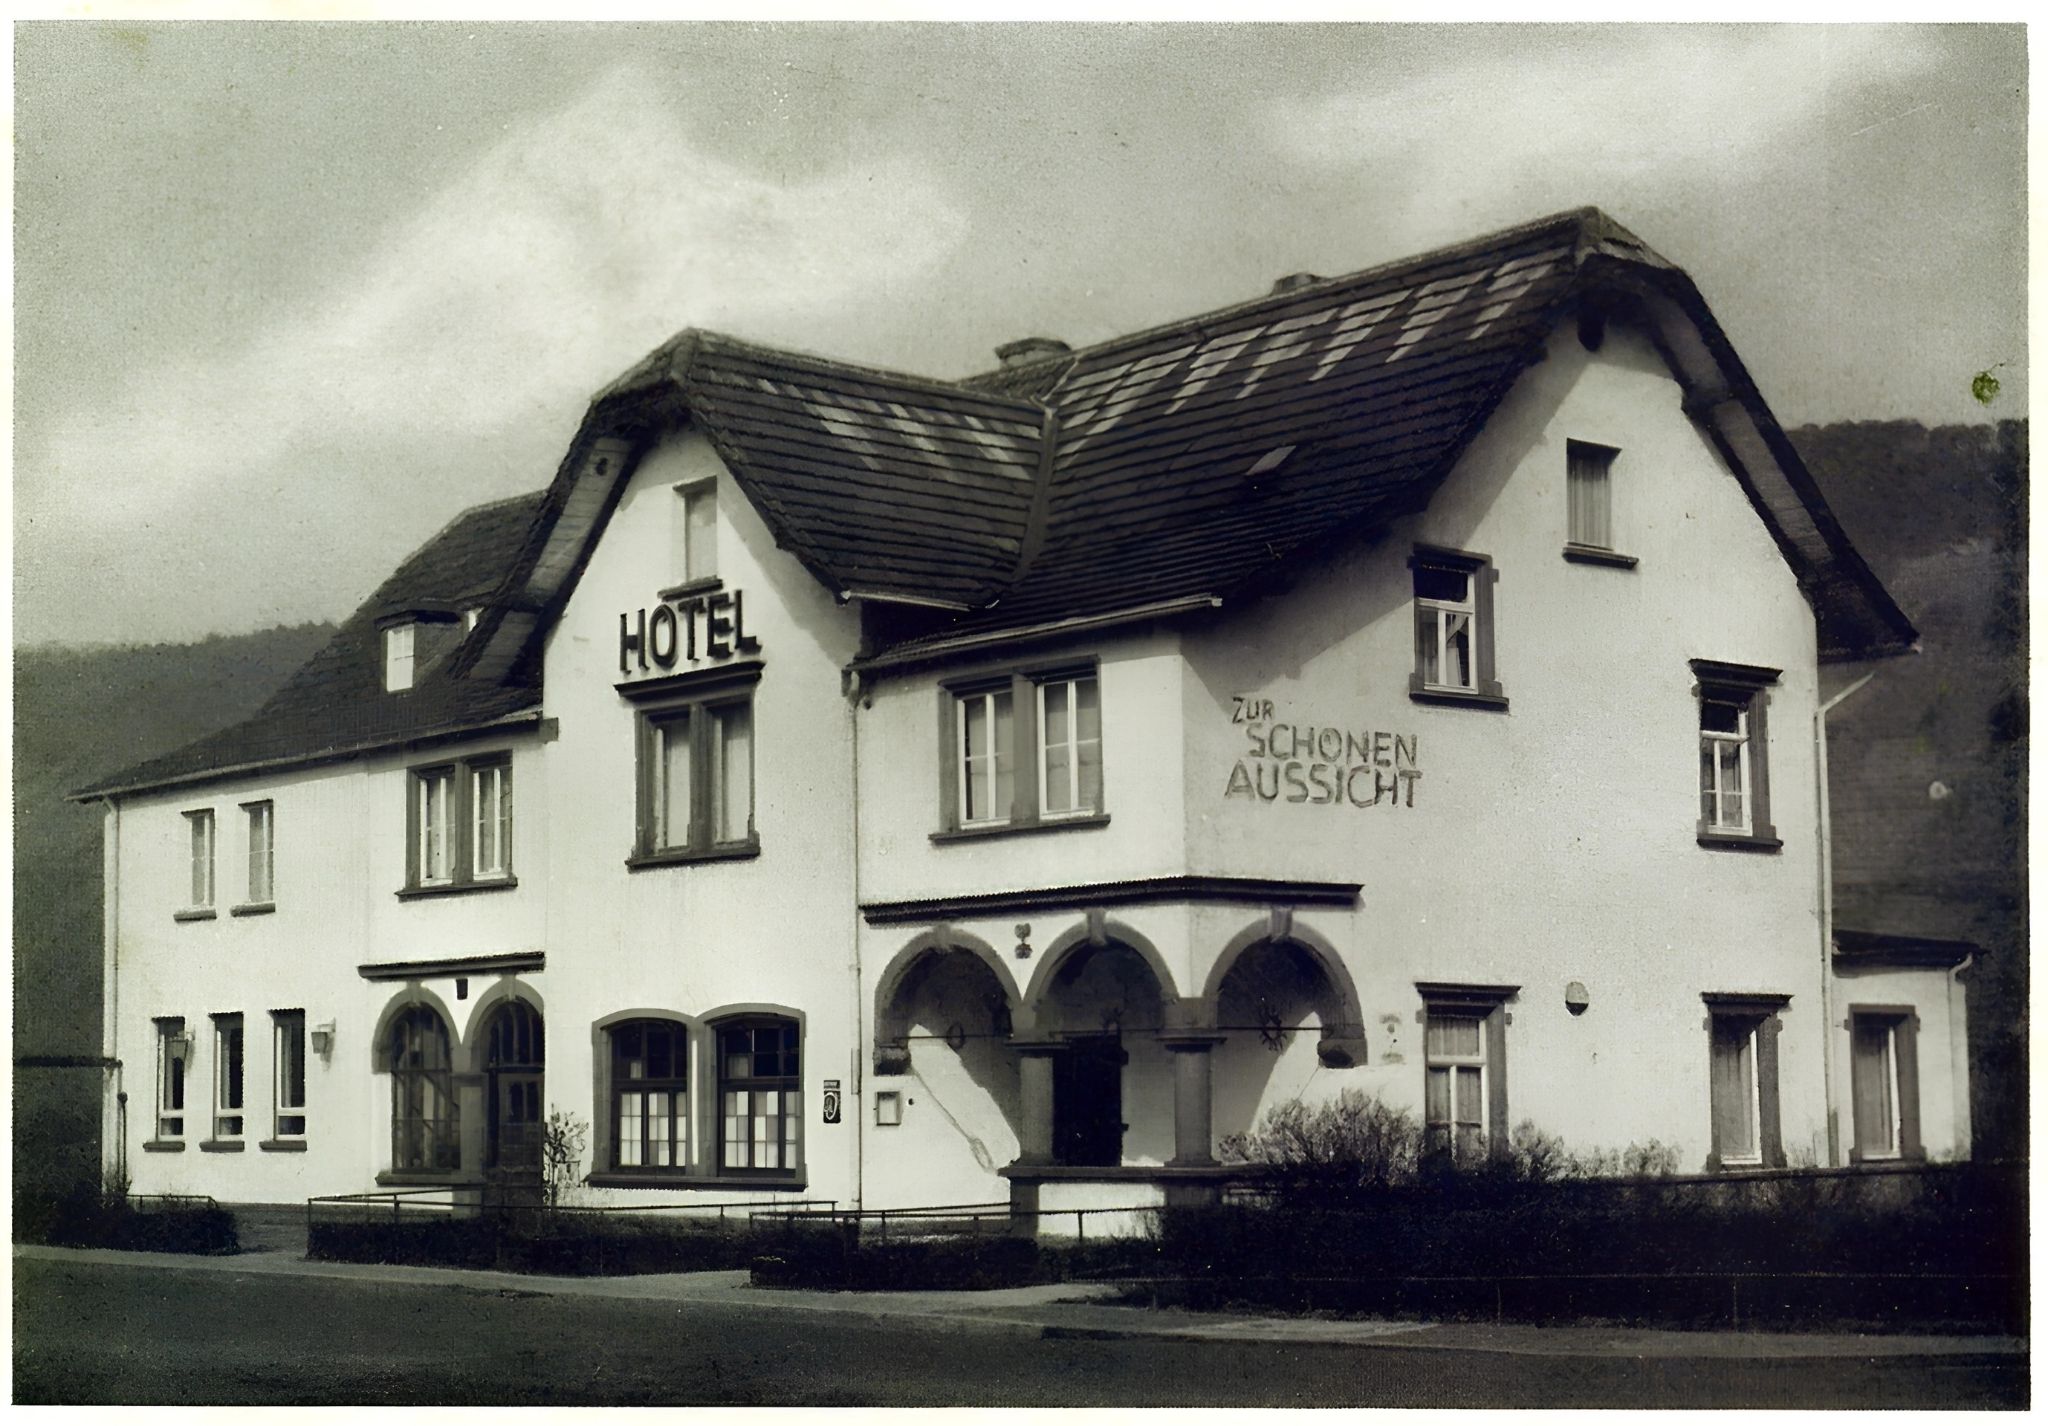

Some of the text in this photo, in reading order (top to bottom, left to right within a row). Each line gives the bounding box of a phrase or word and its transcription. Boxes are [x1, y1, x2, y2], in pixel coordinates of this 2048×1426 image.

[620, 590, 761, 672] HOTEL
[1232, 697, 1274, 724] ZUR
[1224, 760, 1423, 808] AUSSICHT
